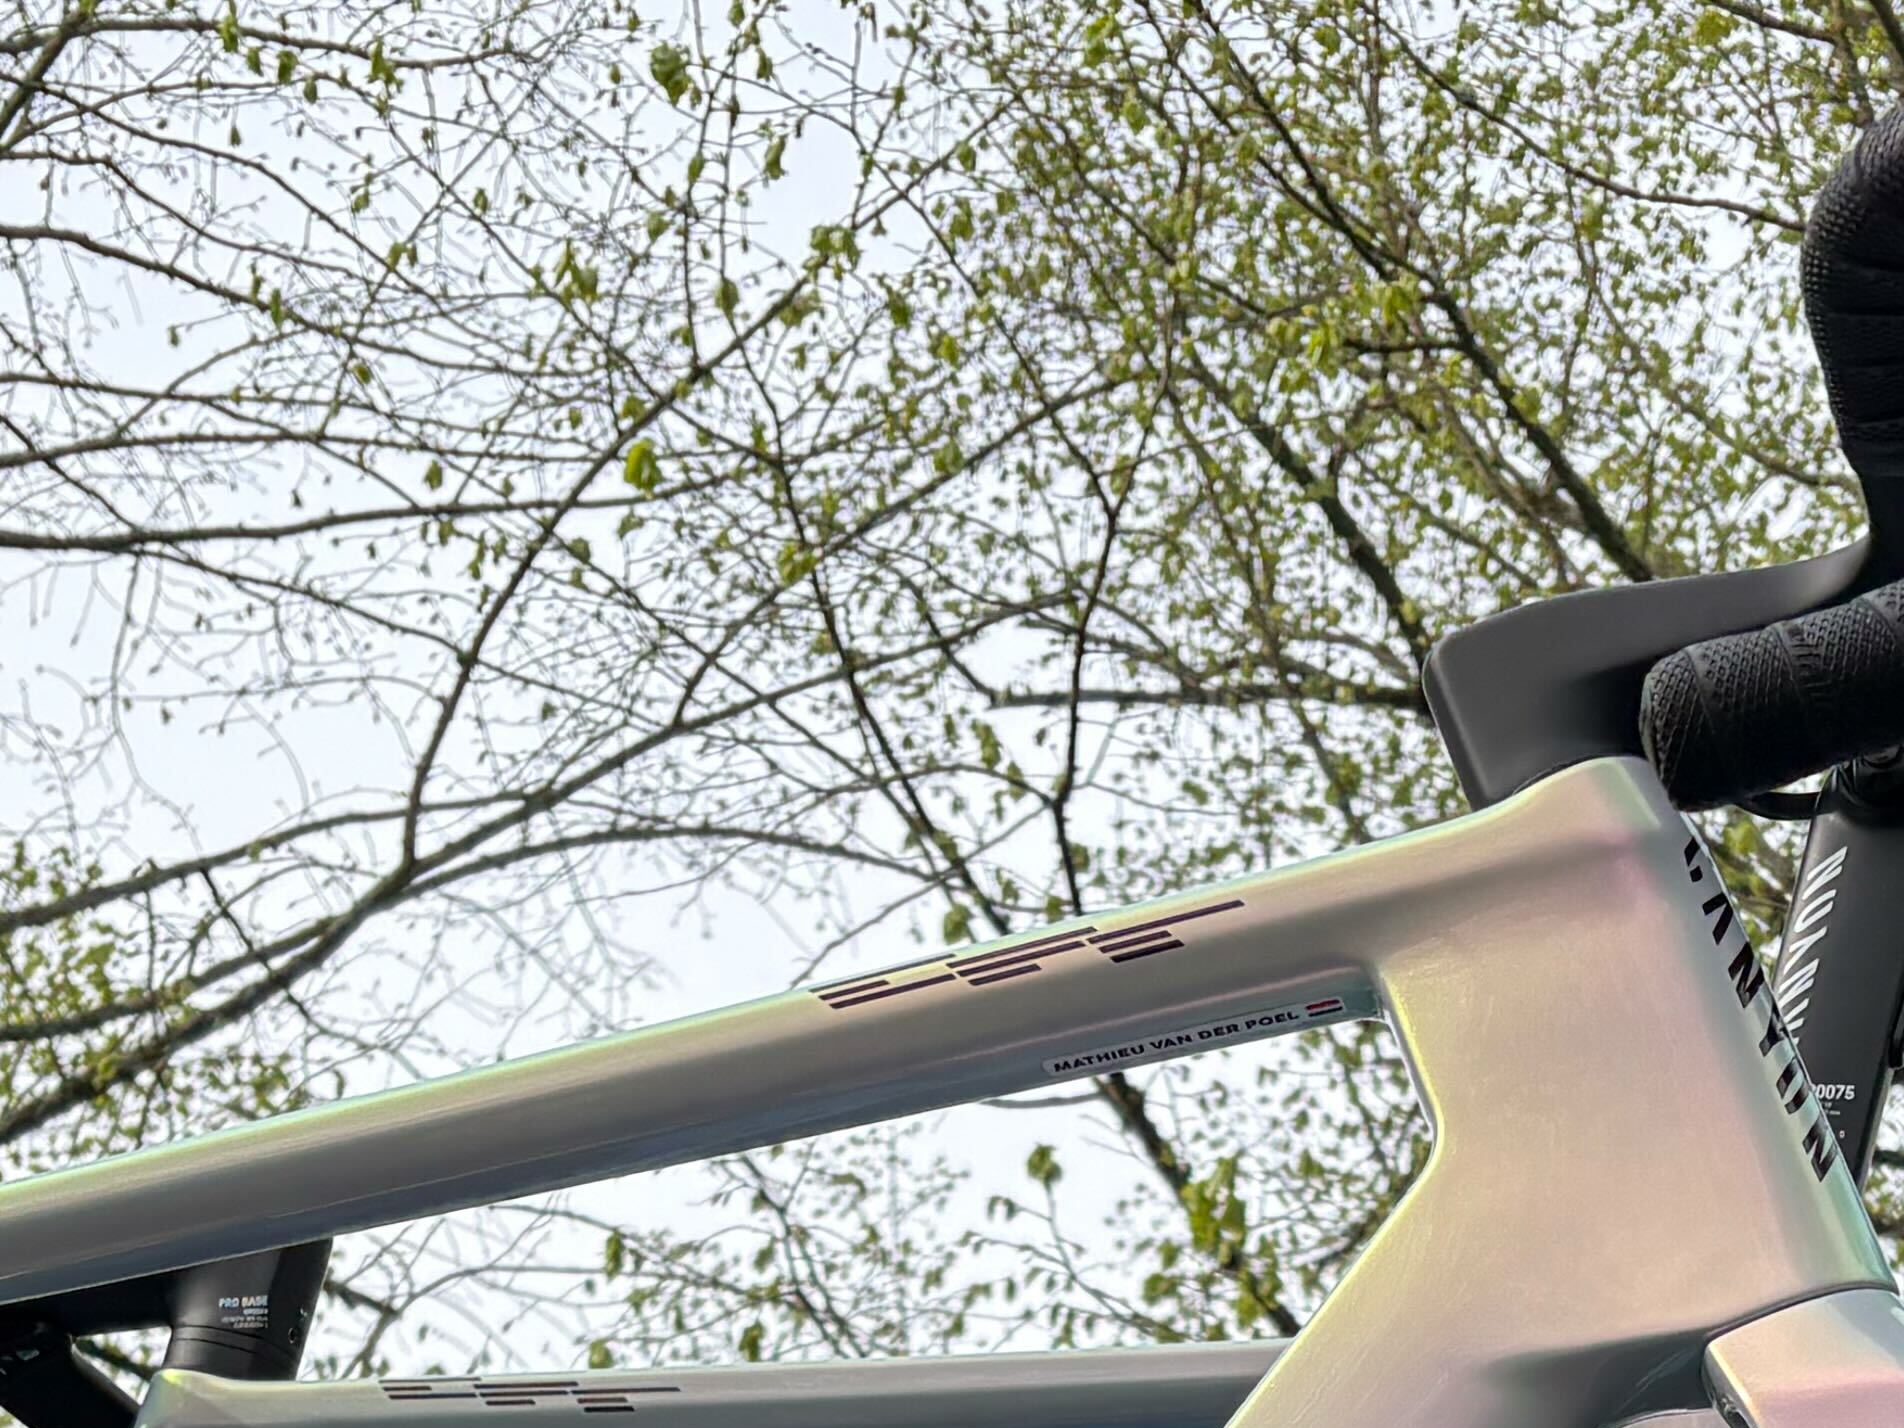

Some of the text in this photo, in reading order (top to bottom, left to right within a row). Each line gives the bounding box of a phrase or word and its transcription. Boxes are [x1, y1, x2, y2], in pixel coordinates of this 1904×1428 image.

[1052, 1010, 1301, 1075] MATHIEU VAN DER POEL
